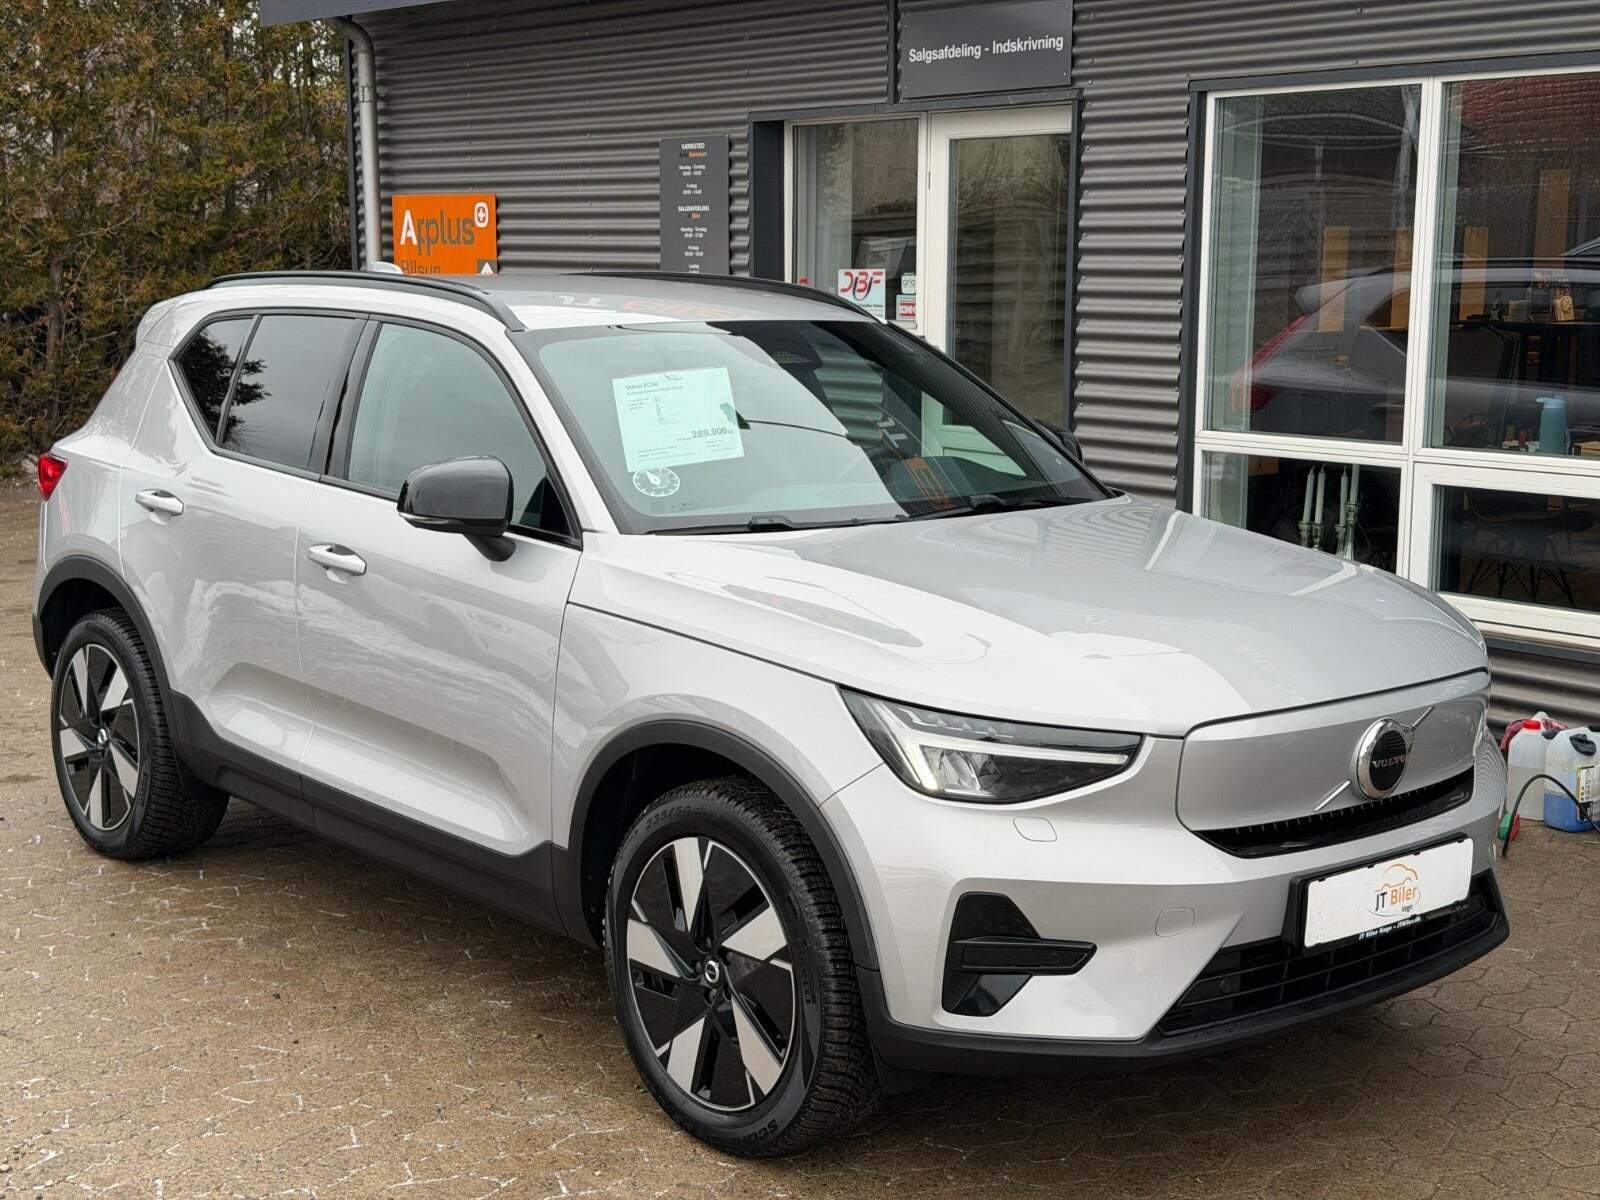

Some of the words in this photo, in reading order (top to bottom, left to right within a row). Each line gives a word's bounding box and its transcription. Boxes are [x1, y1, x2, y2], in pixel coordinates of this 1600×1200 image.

[909, 43, 981, 64] Salgsafdeling
[992, 34, 1064, 54] Indskrivning
[1372, 755, 1406, 769] VOLVO
[1375, 892, 1388, 912] JT
[1390, 886, 1417, 906] Biler
